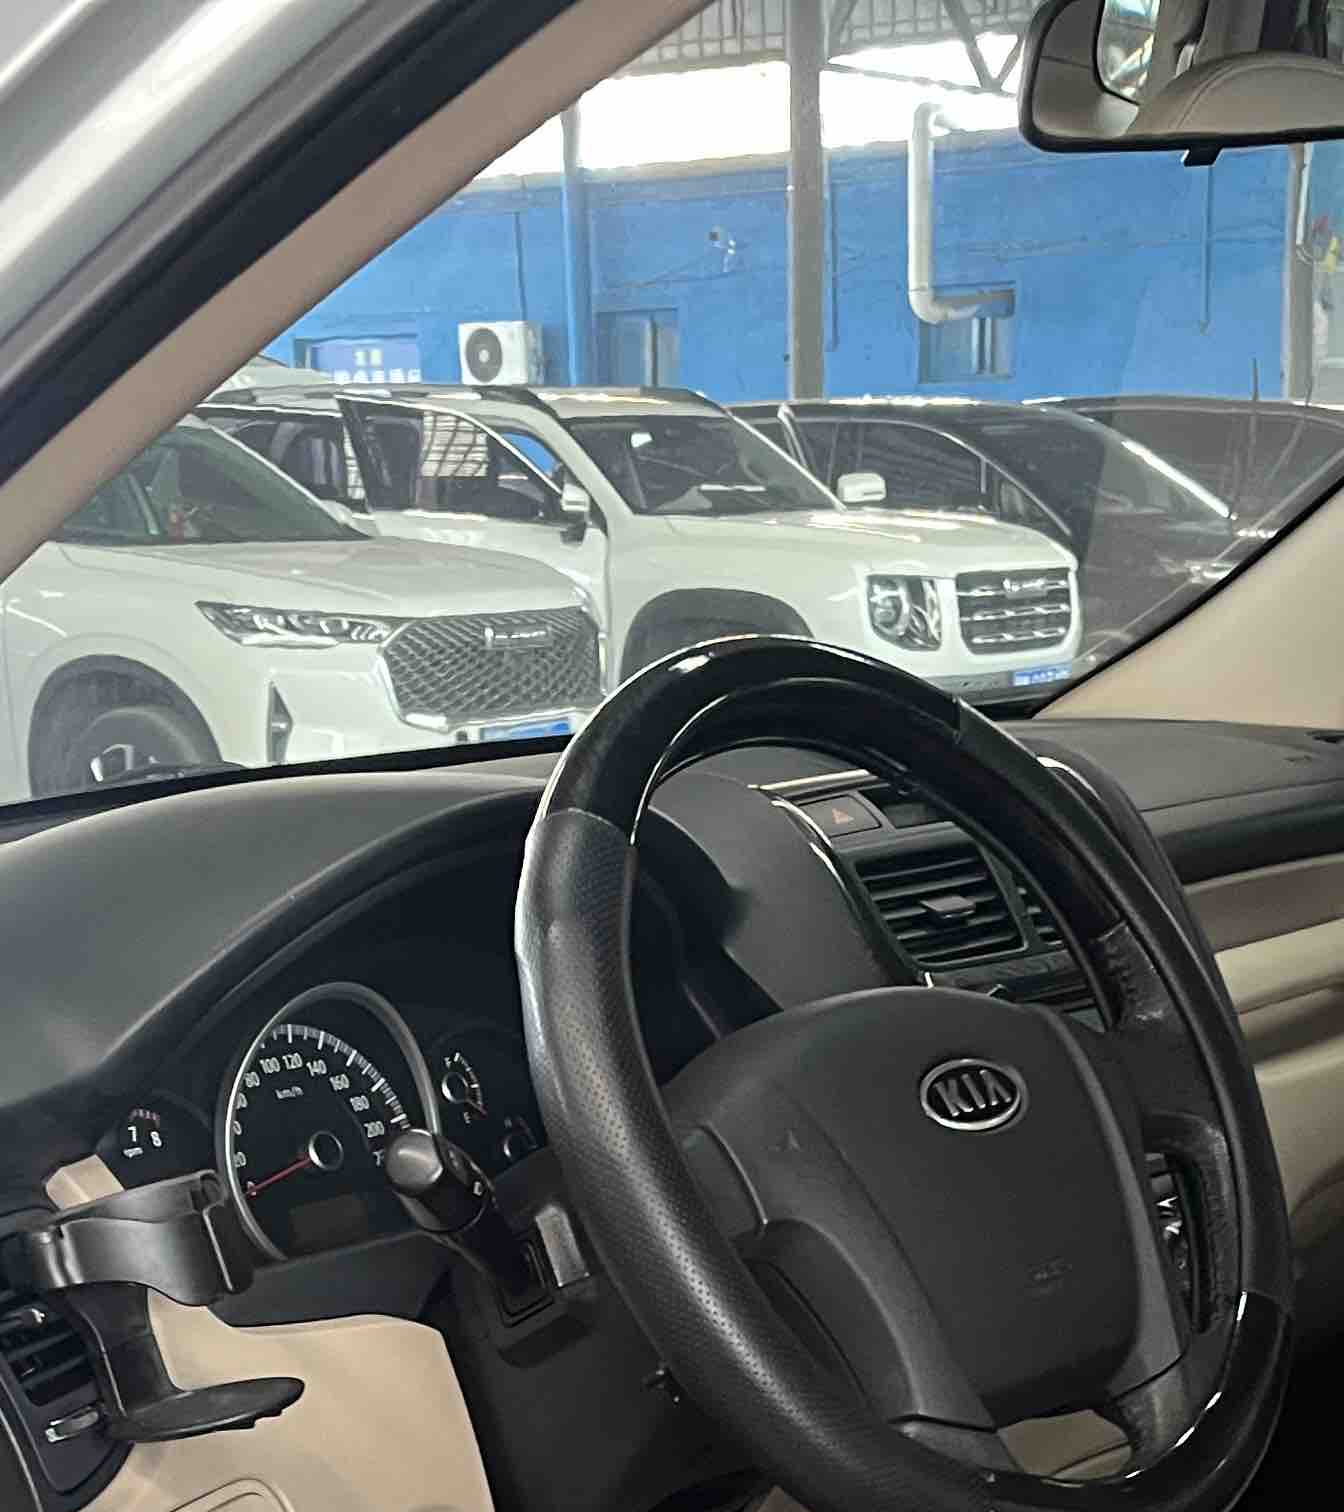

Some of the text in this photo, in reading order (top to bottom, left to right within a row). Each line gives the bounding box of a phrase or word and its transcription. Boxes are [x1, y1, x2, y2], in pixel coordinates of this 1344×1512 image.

[260, 1057, 281, 1074] 100
[282, 1053, 303, 1070] 120
[306, 1059, 327, 1076] 140
[244, 1071, 260, 1088] 80
[329, 1073, 350, 1091] 160
[933, 1069, 1012, 1116] KIA
[349, 1095, 370, 1112] 180
[363, 1120, 385, 1138] 200
